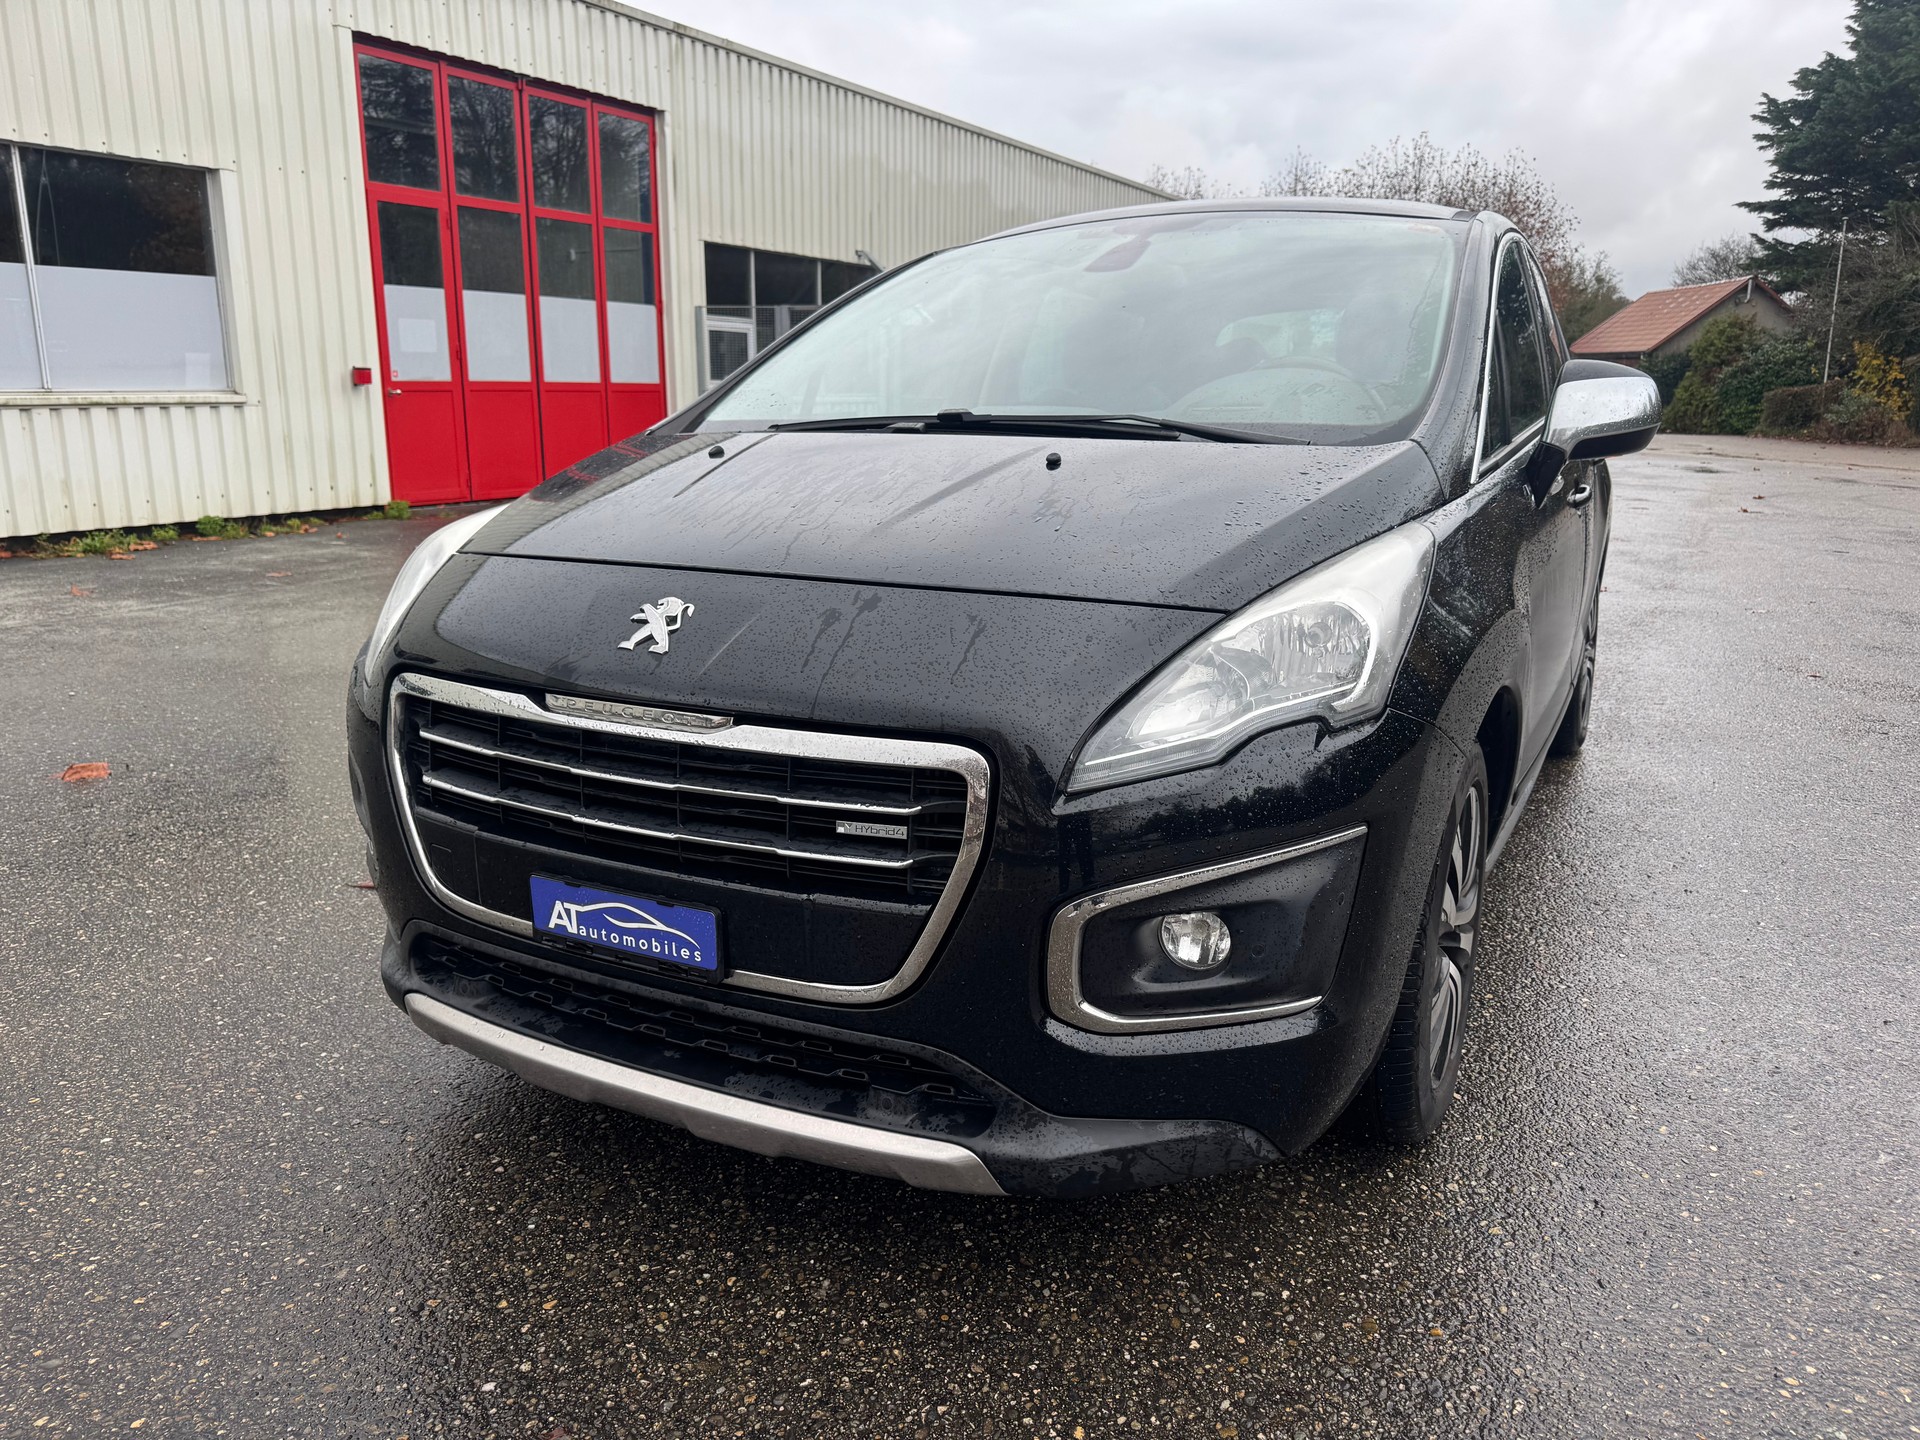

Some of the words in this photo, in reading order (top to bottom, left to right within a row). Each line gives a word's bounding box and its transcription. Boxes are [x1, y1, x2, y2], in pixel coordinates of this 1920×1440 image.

[566, 698, 697, 726] PEUGEOT
[548, 900, 583, 934] AT
[578, 925, 702, 962] automobiles
